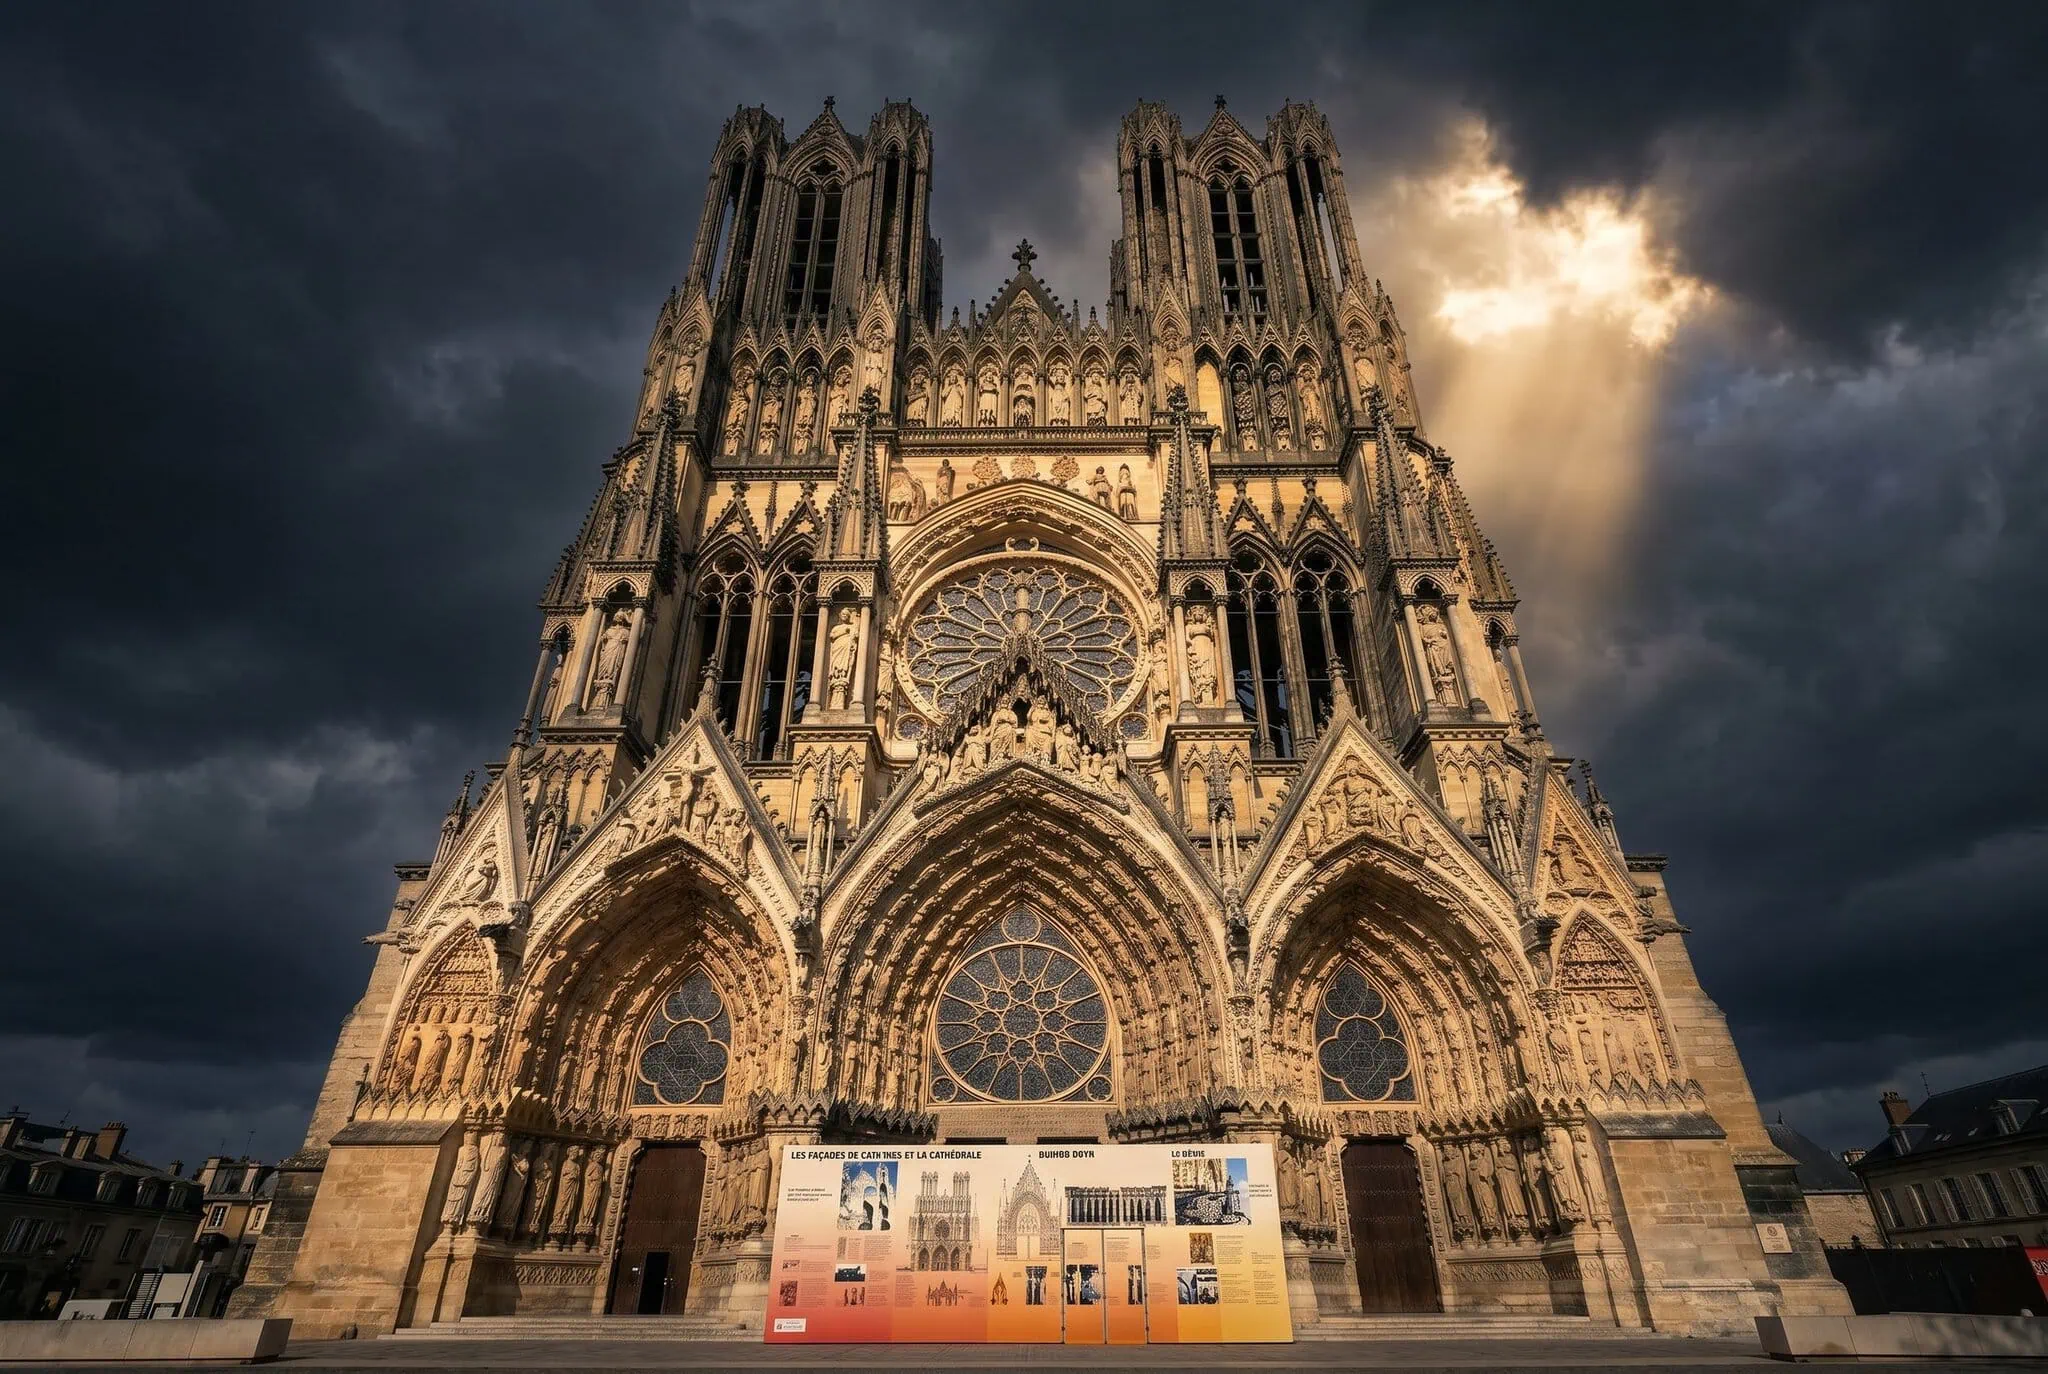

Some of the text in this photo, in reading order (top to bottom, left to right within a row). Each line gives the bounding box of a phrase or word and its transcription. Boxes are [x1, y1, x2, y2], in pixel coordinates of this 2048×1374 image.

[791, 1151, 806, 1160] LES
[848, 1151, 859, 1160] DE
[904, 1151, 915, 1160] ET
[917, 1151, 928, 1160] LA
[929, 1149, 983, 1160] CATHÉDRALE
